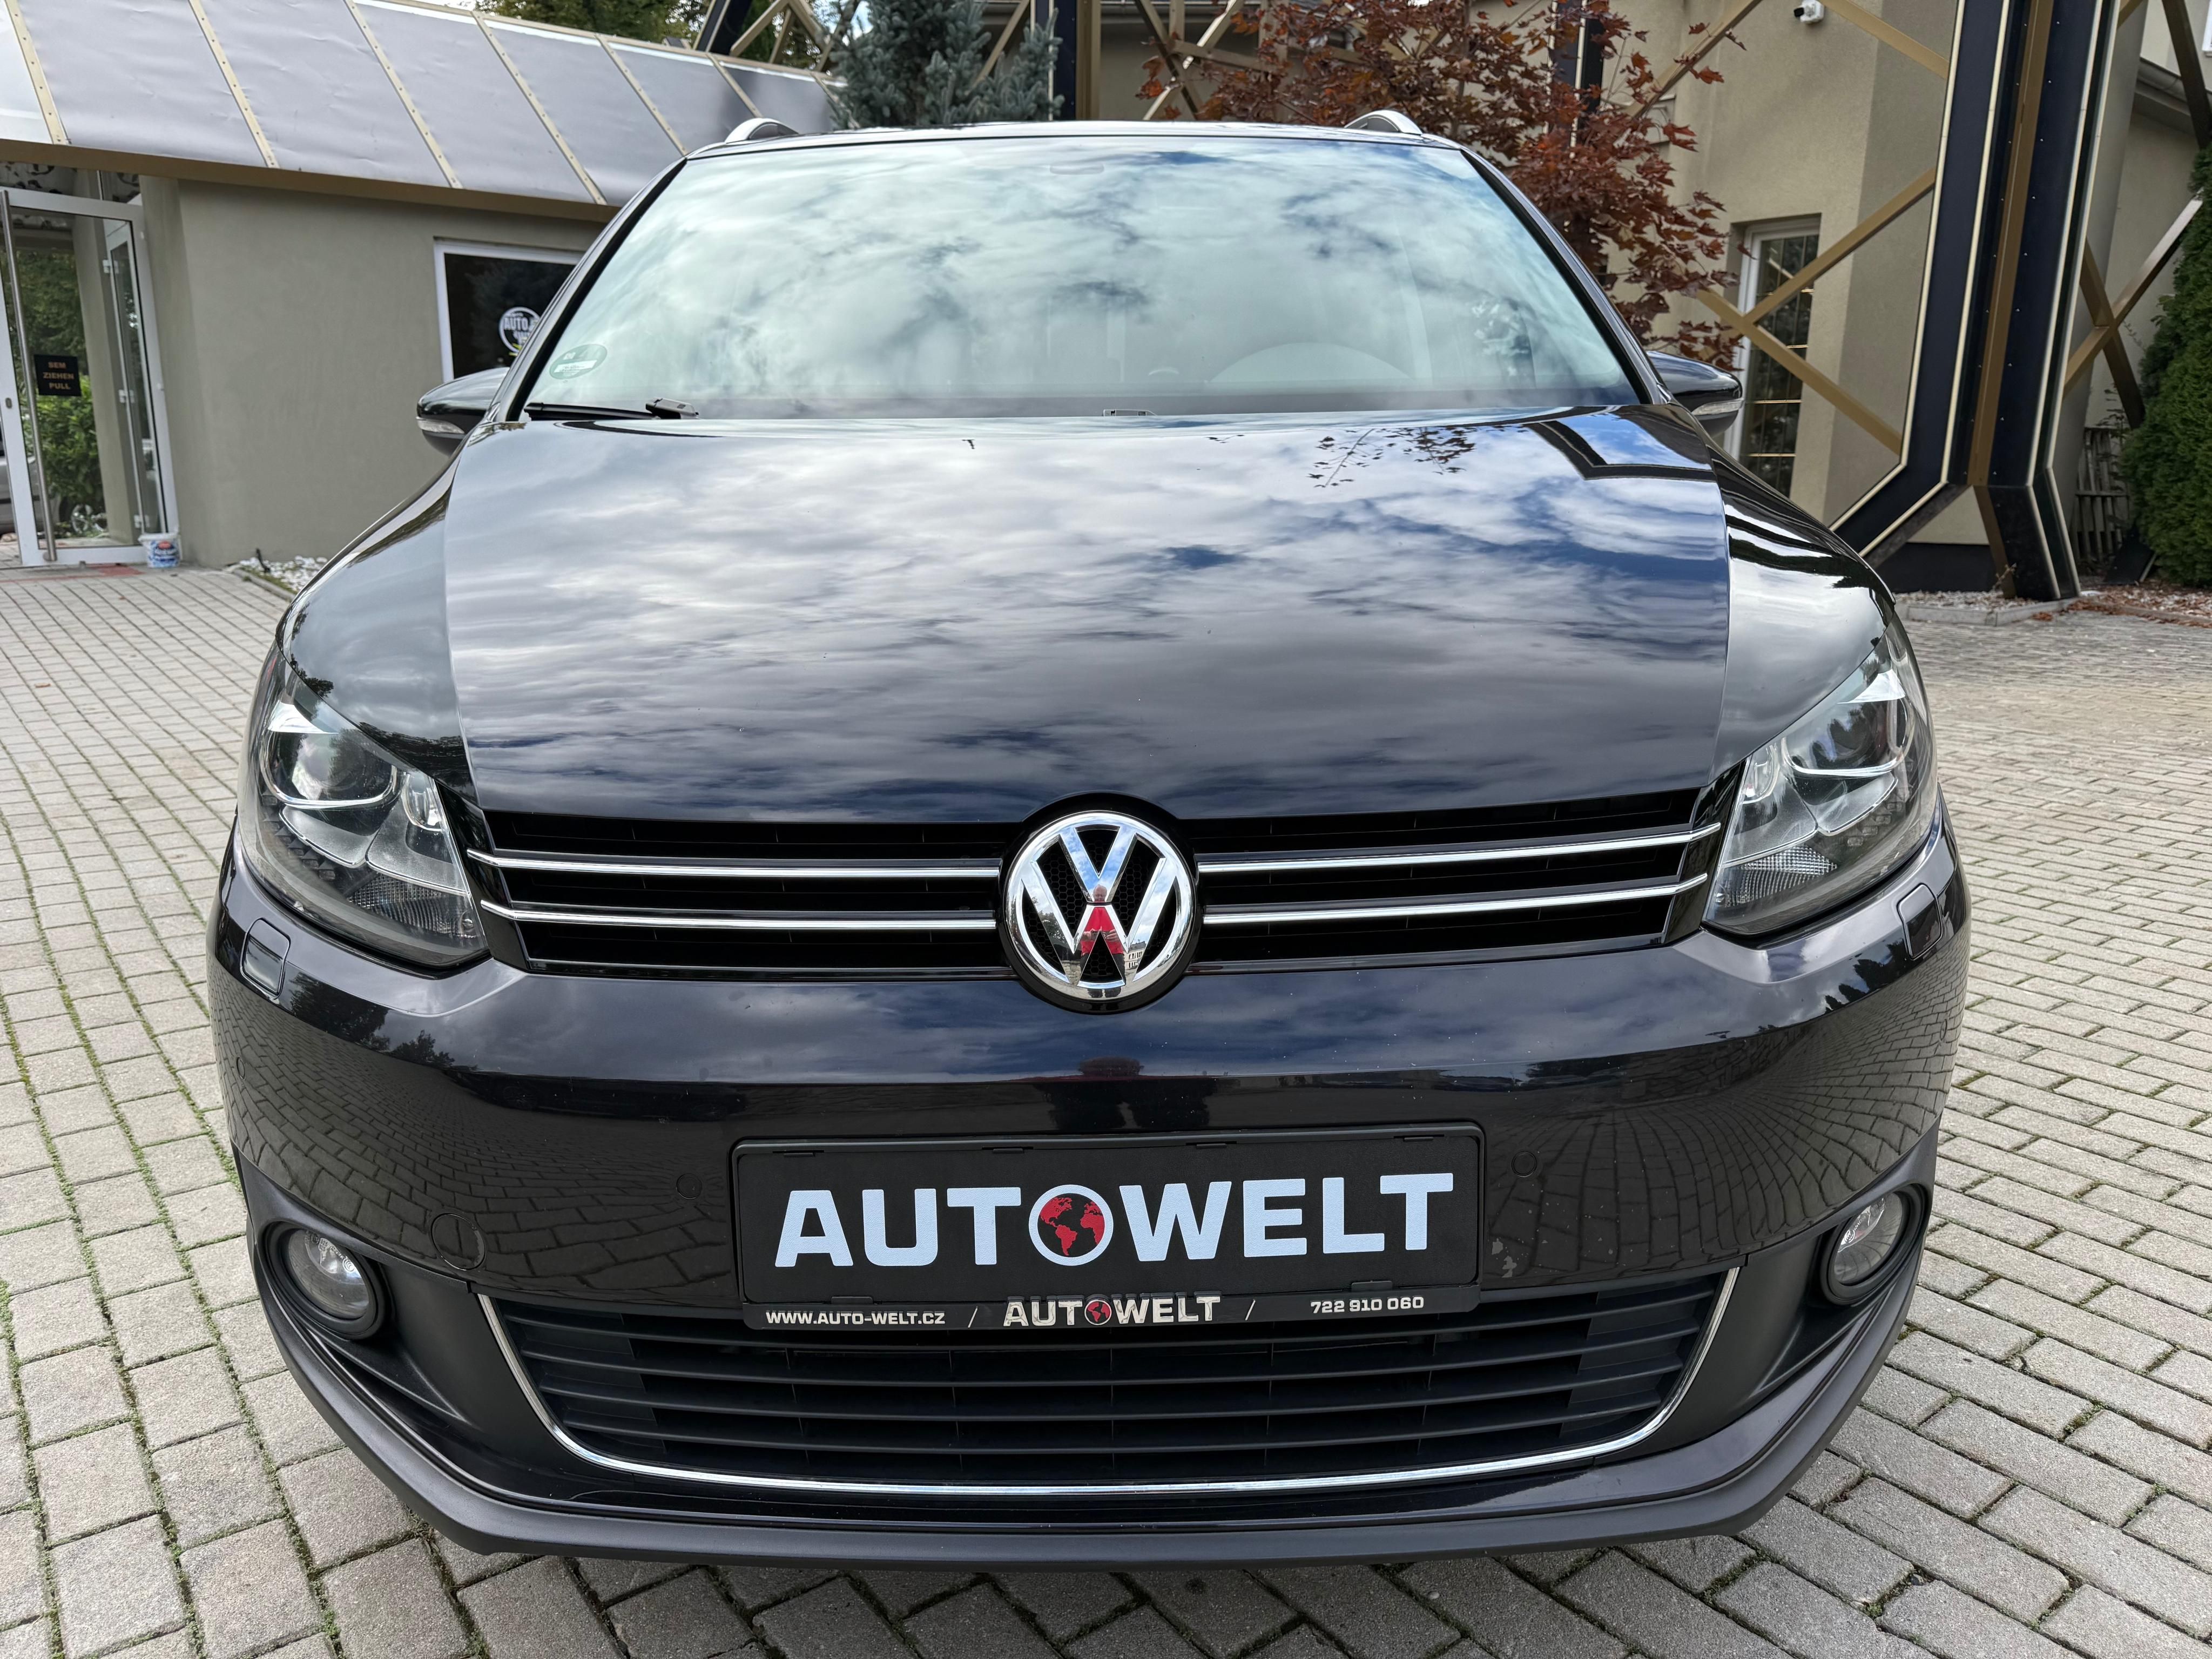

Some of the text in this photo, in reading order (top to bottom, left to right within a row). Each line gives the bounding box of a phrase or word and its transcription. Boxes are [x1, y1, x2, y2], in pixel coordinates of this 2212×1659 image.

[43, 372, 75, 380] ZIEHEN
[775, 1172, 1453, 1267] AUTOWELT
[765, 1311, 946, 1325] WWW.AUTO-WELT.CZ
[1003, 1296, 1220, 1326] AUTOWELT
[1310, 1300, 1345, 1313] 722
[1349, 1298, 1382, 1312] 910
[1387, 1296, 1424, 1310] 060
